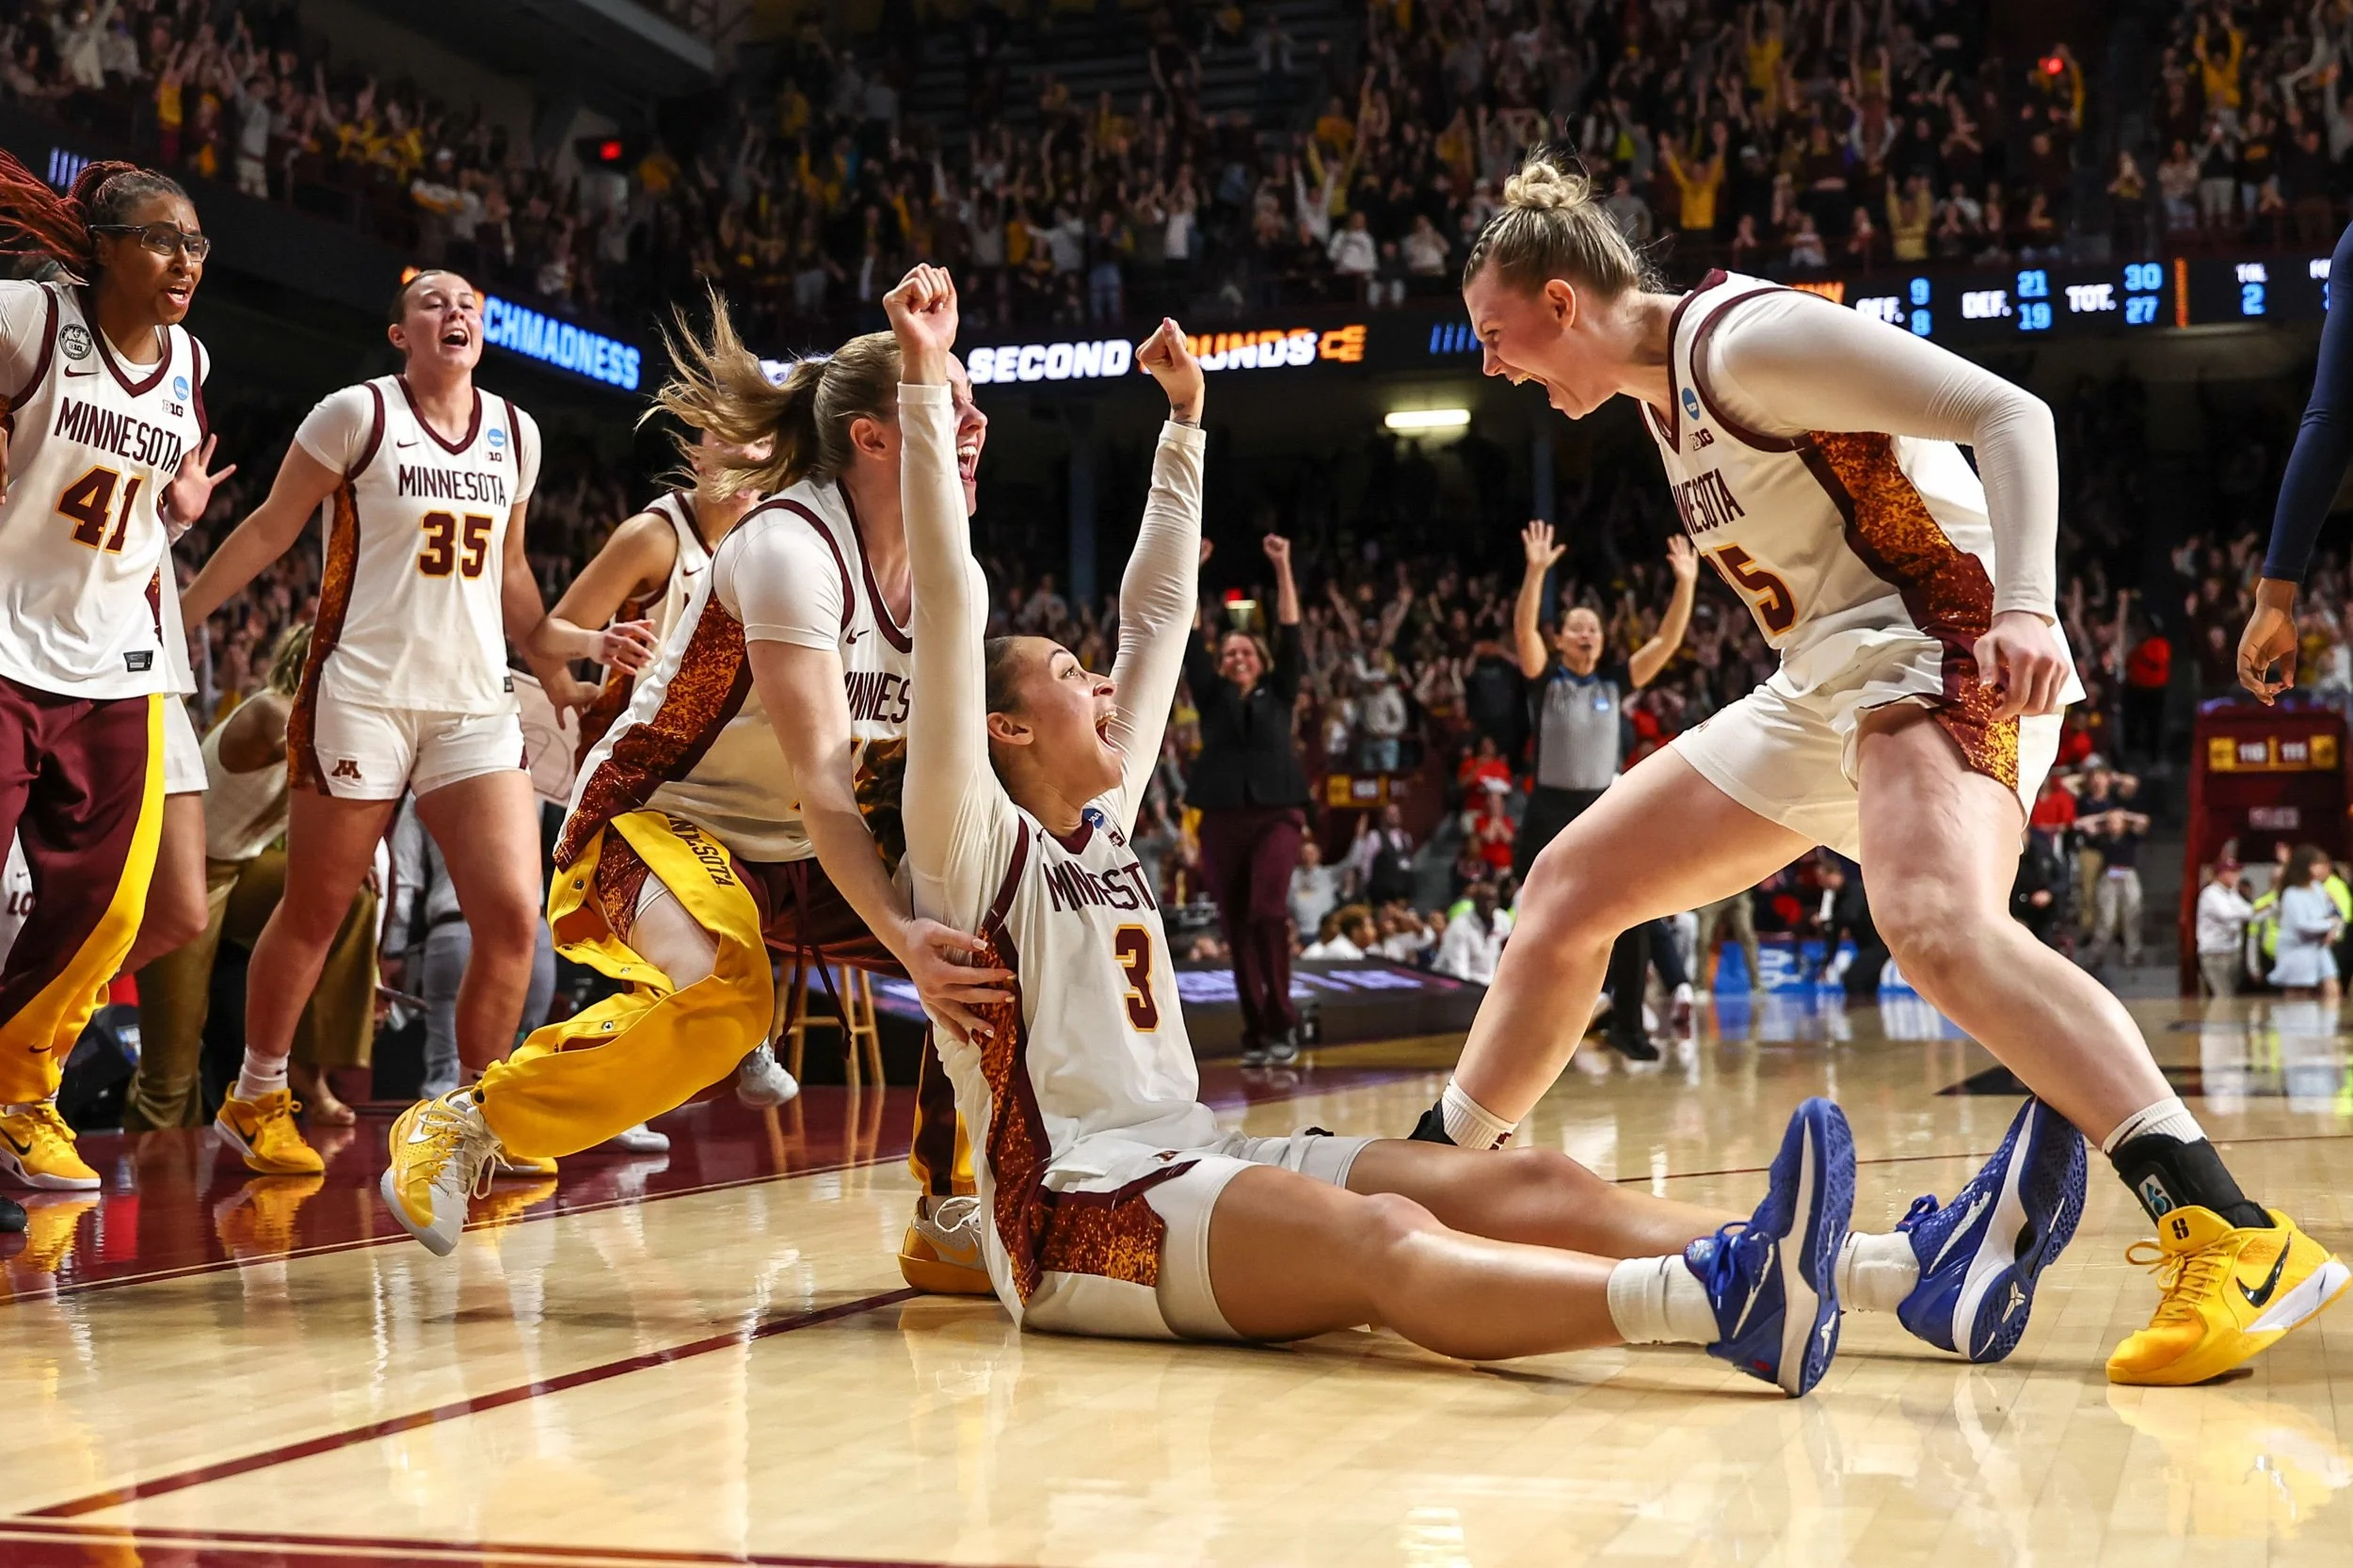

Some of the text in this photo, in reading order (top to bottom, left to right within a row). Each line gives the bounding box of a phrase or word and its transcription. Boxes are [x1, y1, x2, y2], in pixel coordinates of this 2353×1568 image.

[2018, 270, 2047, 297] 21
[2124, 263, 2162, 291] 30
[2242, 283, 2265, 315] 2
[2018, 302, 2052, 329] 19
[2125, 296, 2159, 324] 27
[480, 294, 642, 391] CHMADNESS
[968, 328, 1318, 384] SECOND UNDS
[54, 396, 182, 473] MINNESOTA
[55, 464, 144, 554] 41
[398, 463, 506, 507] MINNESOTA
[1673, 468, 1746, 536] NESOTA
[416, 510, 493, 580] 35
[1114, 923, 1160, 1032] 3
